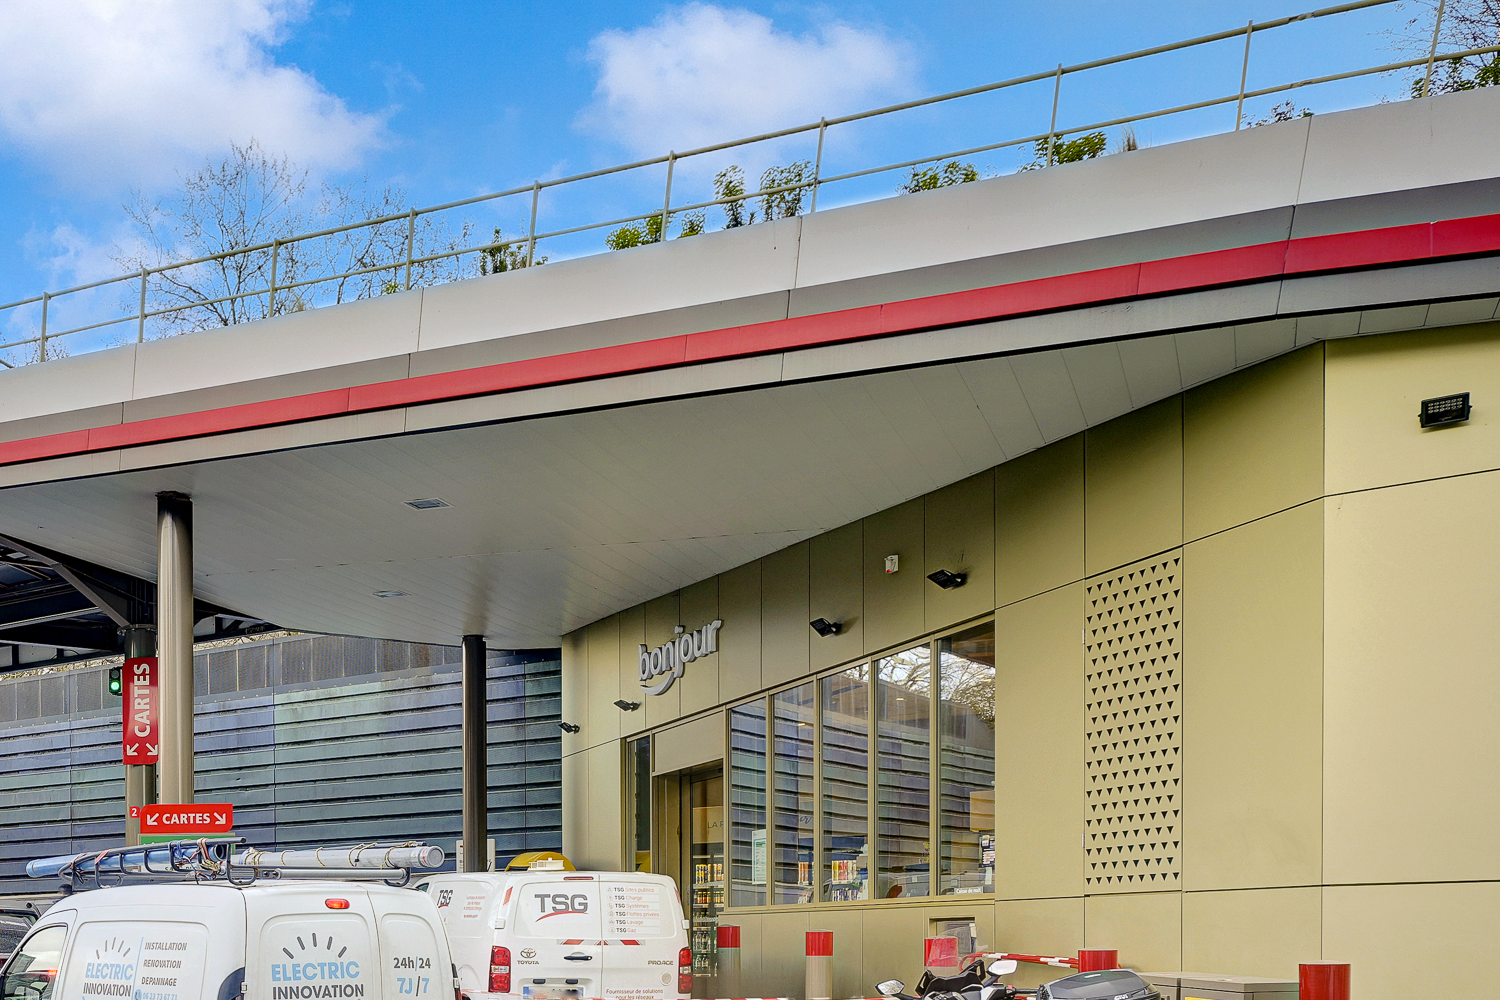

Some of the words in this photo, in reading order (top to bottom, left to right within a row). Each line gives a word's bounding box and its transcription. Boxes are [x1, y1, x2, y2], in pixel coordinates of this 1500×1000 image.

[638, 619, 722, 682] bonjour
[134, 662, 151, 738] CARTES
[131, 808, 138, 817] 2
[162, 813, 211, 824] CARTES
[437, 890, 453, 906] TSG
[534, 894, 589, 913] TSG
[144, 942, 188, 951] INSTALLATION
[143, 959, 182, 969] RENOVATION
[393, 956, 432, 971] 24h/24
[85, 962, 134, 981] ELECTRIC
[271, 961, 360, 982] ELECTRIC
[141, 976, 178, 987] DEPANNAGE
[83, 982, 132, 997] INNOVATION
[272, 984, 364, 1000] INNOVATION
